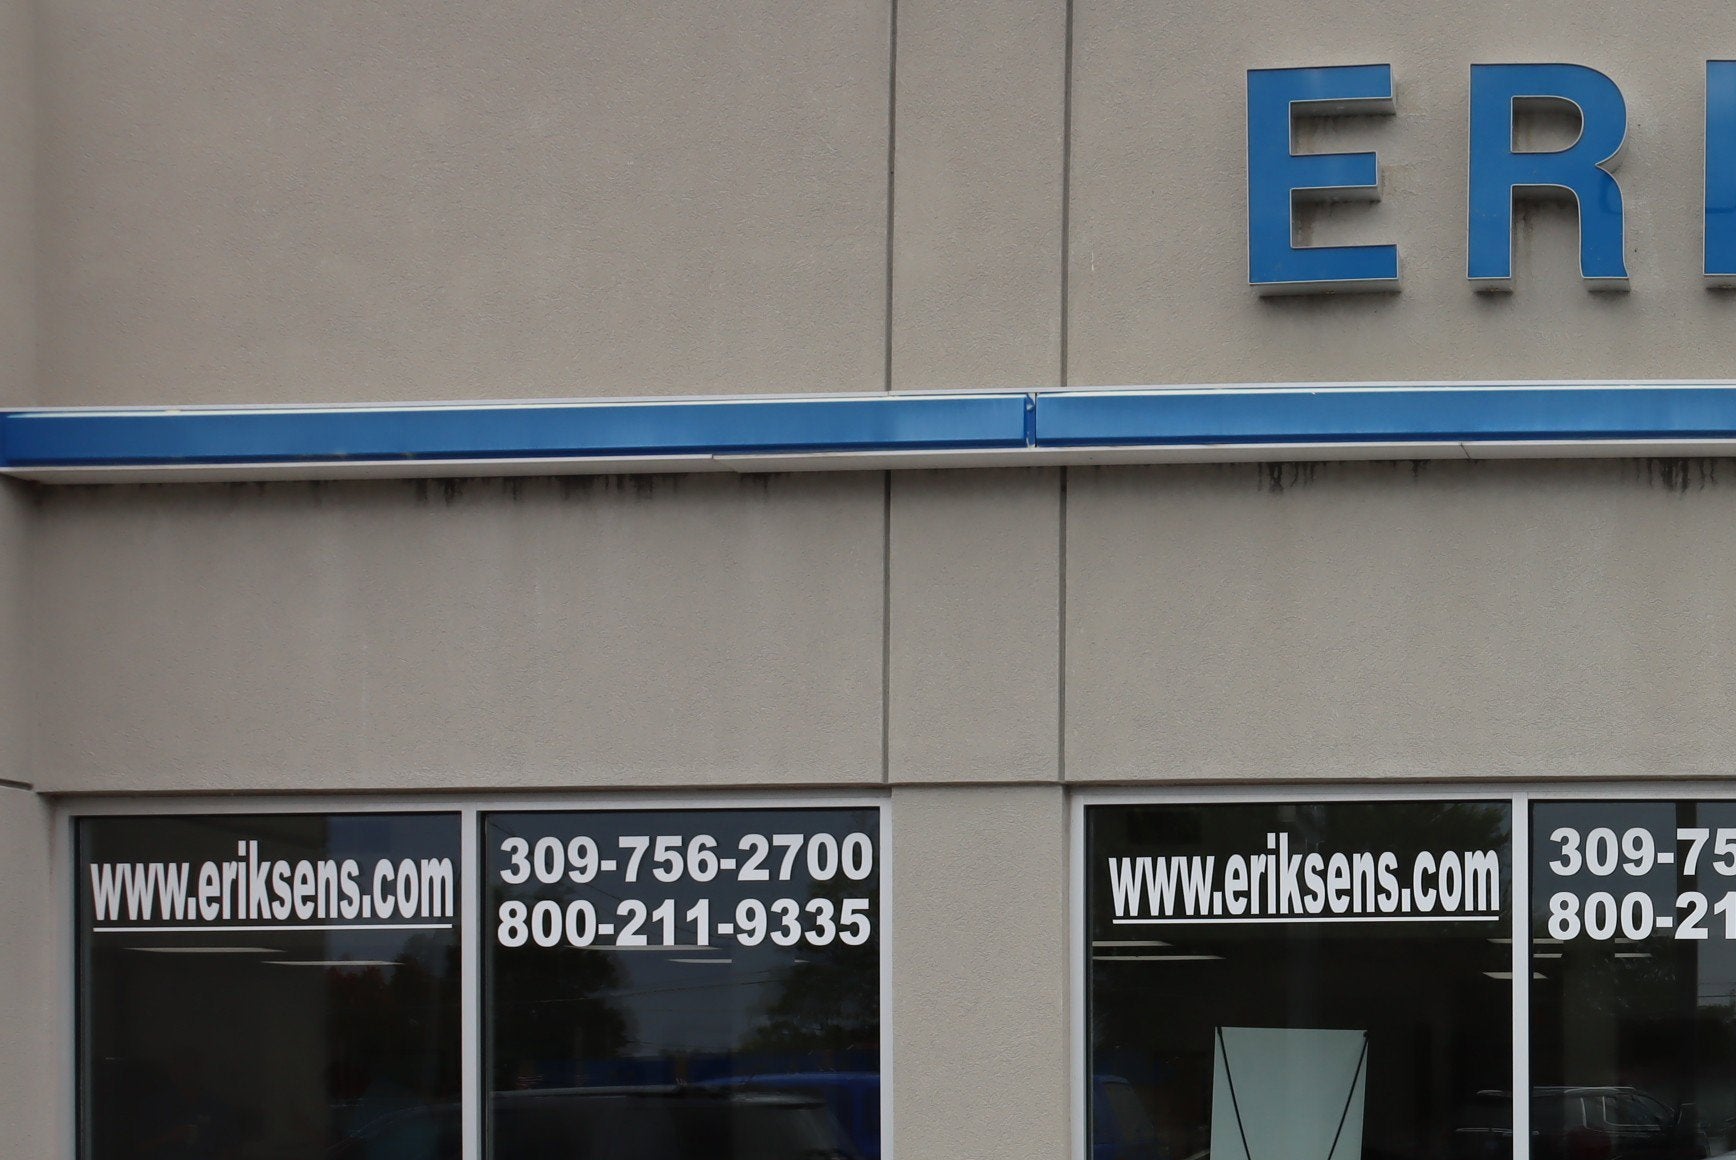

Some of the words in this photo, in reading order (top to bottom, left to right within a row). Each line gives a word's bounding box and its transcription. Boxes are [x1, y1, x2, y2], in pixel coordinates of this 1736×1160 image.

[91, 840, 454, 922] www.eriksens.com
[500, 832, 873, 884] 309-756-2700
[1109, 832, 1500, 916] www.eriksens.com
[497, 897, 871, 947] 800-211-9335
